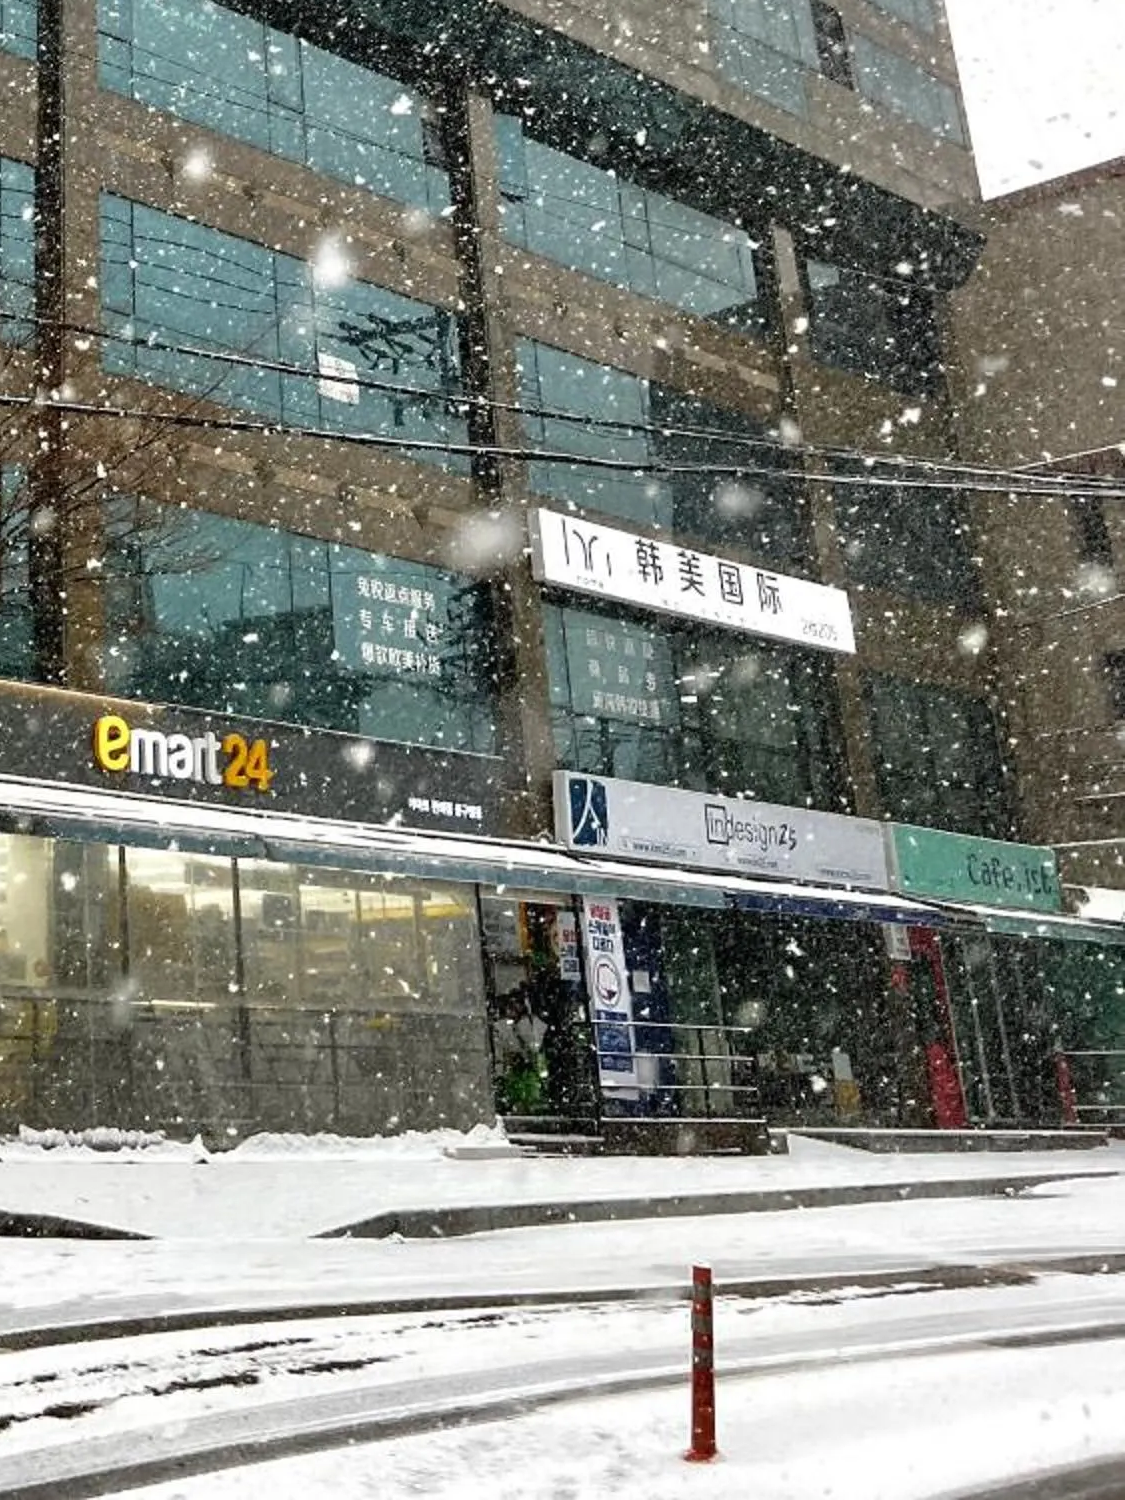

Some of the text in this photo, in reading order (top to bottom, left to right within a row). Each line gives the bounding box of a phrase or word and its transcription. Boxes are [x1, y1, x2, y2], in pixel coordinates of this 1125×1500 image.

[635, 538, 782, 614] 韩美国际
[94, 714, 275, 792] emart24
